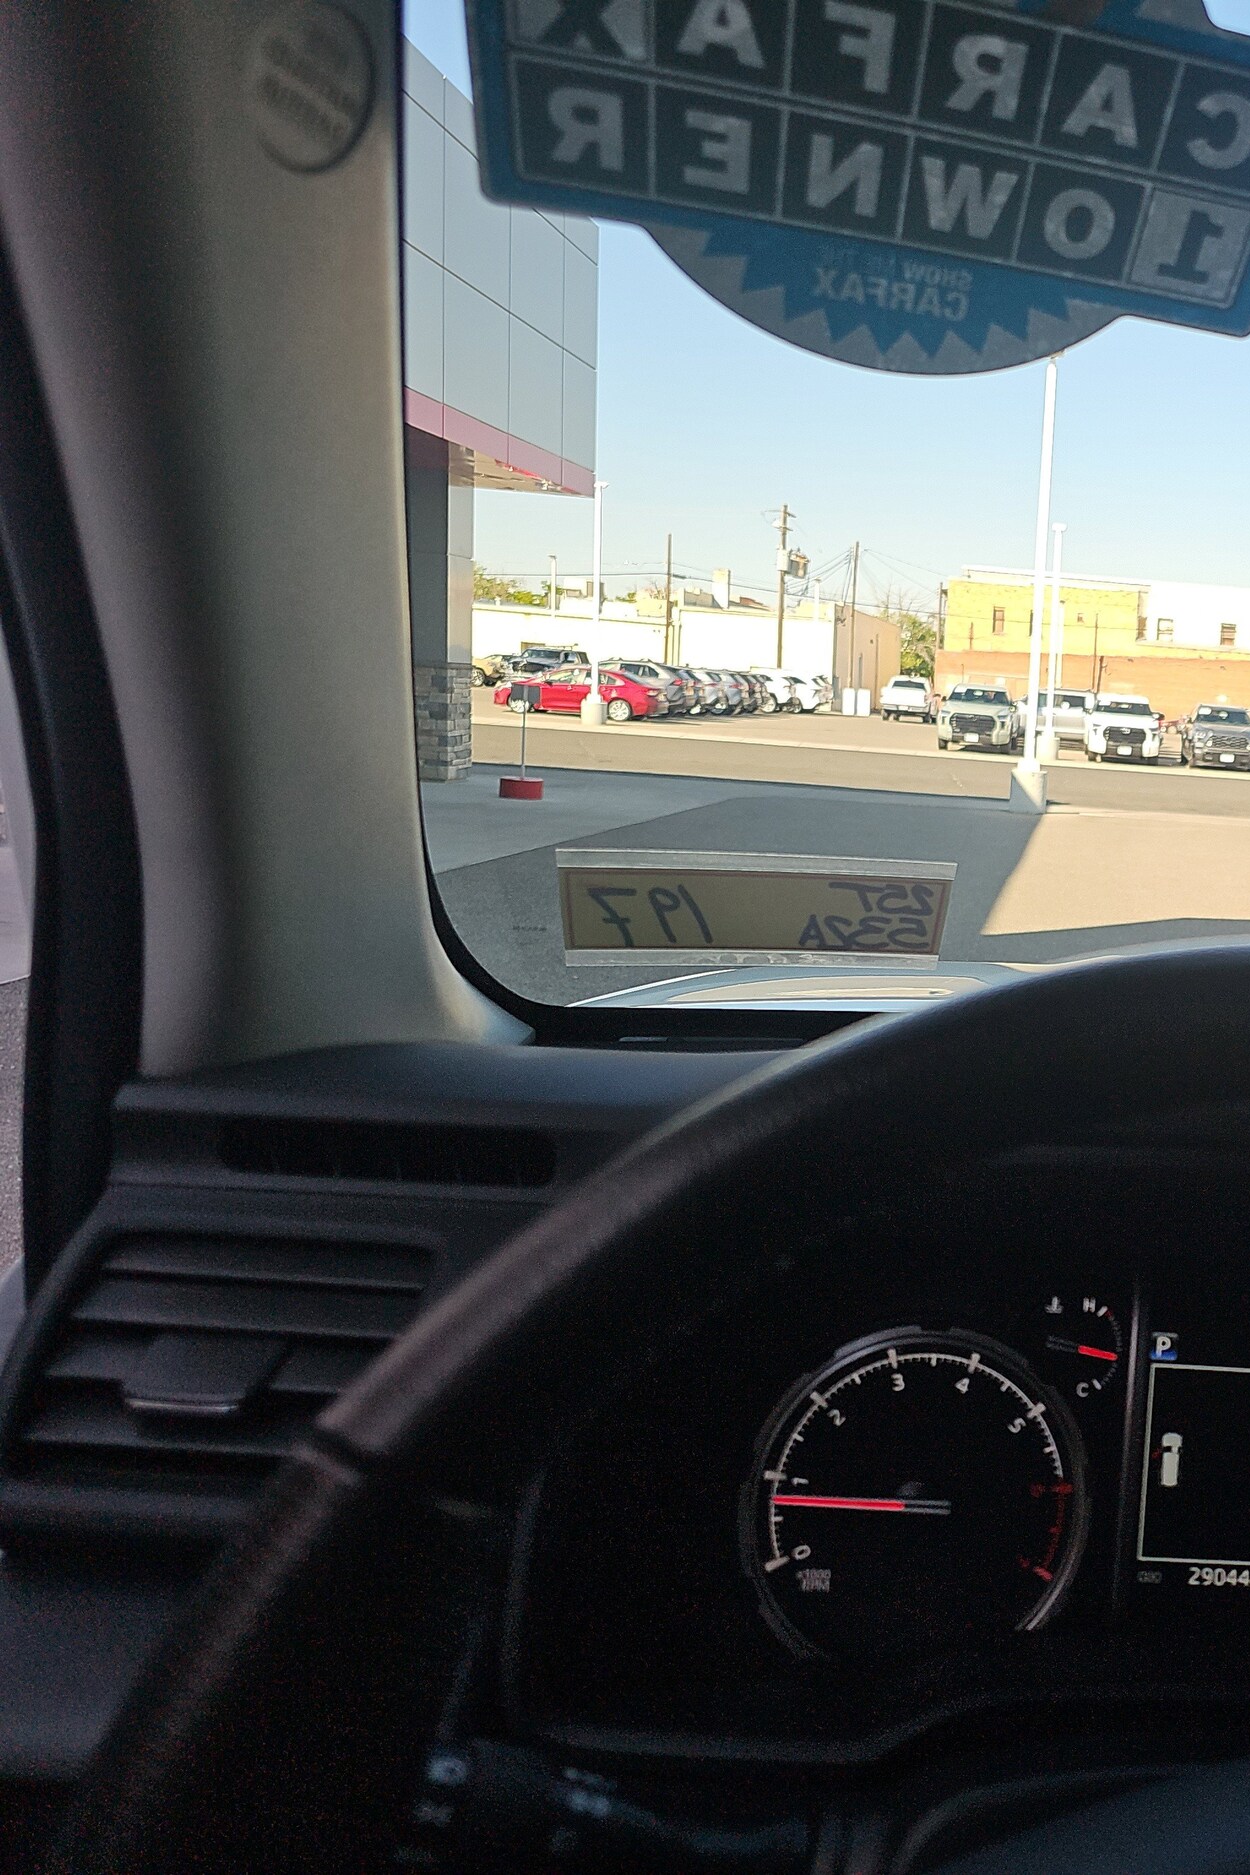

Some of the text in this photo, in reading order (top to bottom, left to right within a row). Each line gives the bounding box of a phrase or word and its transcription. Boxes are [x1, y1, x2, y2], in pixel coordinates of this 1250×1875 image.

[1082, 1299, 1097, 1313] H
[1156, 1336, 1172, 1357] P
[891, 1373, 905, 1391] 3
[955, 1378, 970, 1394] 4
[1076, 1382, 1090, 1398] C
[828, 1408, 846, 1427] 2
[1008, 1417, 1026, 1434] 5
[790, 1476, 808, 1486] 1
[791, 1544, 812, 1561] 0
[1188, 1566, 1250, 1586] 29044
